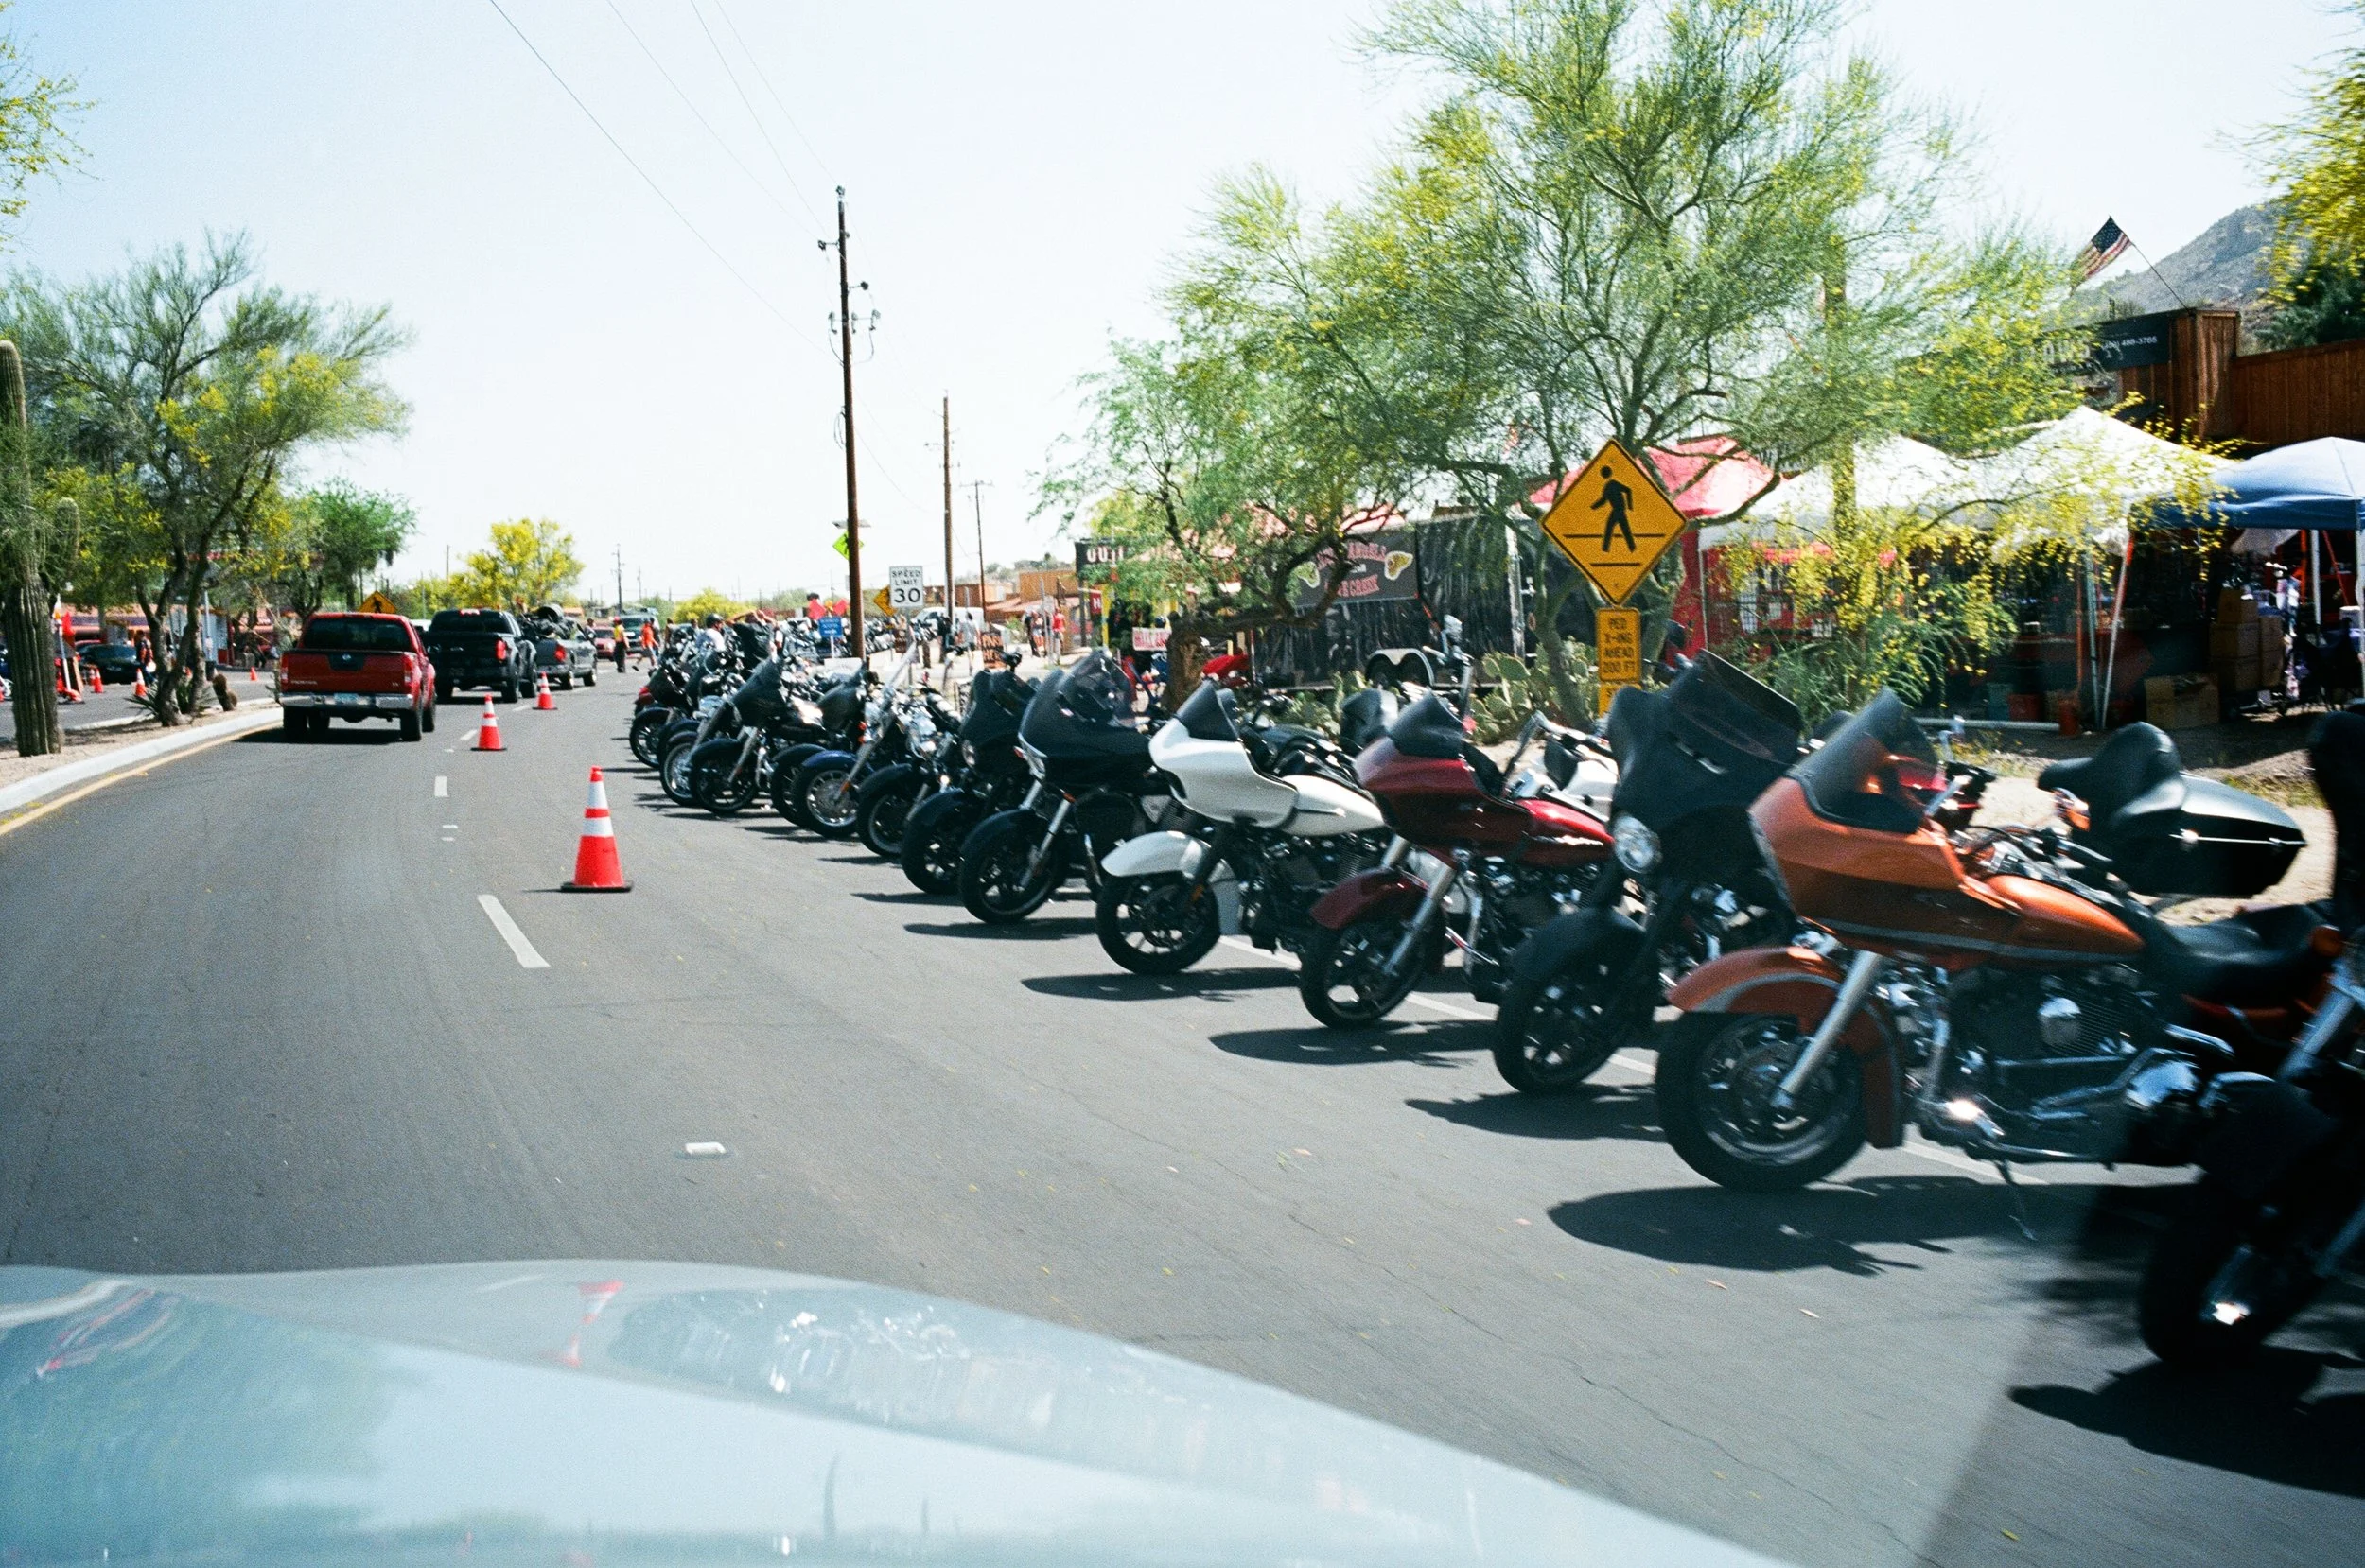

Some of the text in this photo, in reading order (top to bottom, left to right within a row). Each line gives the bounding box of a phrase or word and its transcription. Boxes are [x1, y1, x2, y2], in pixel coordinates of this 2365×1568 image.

[891, 569, 921, 578] SPEED
[894, 587, 920, 603] 30
[1604, 647, 1634, 659] AHEAD
